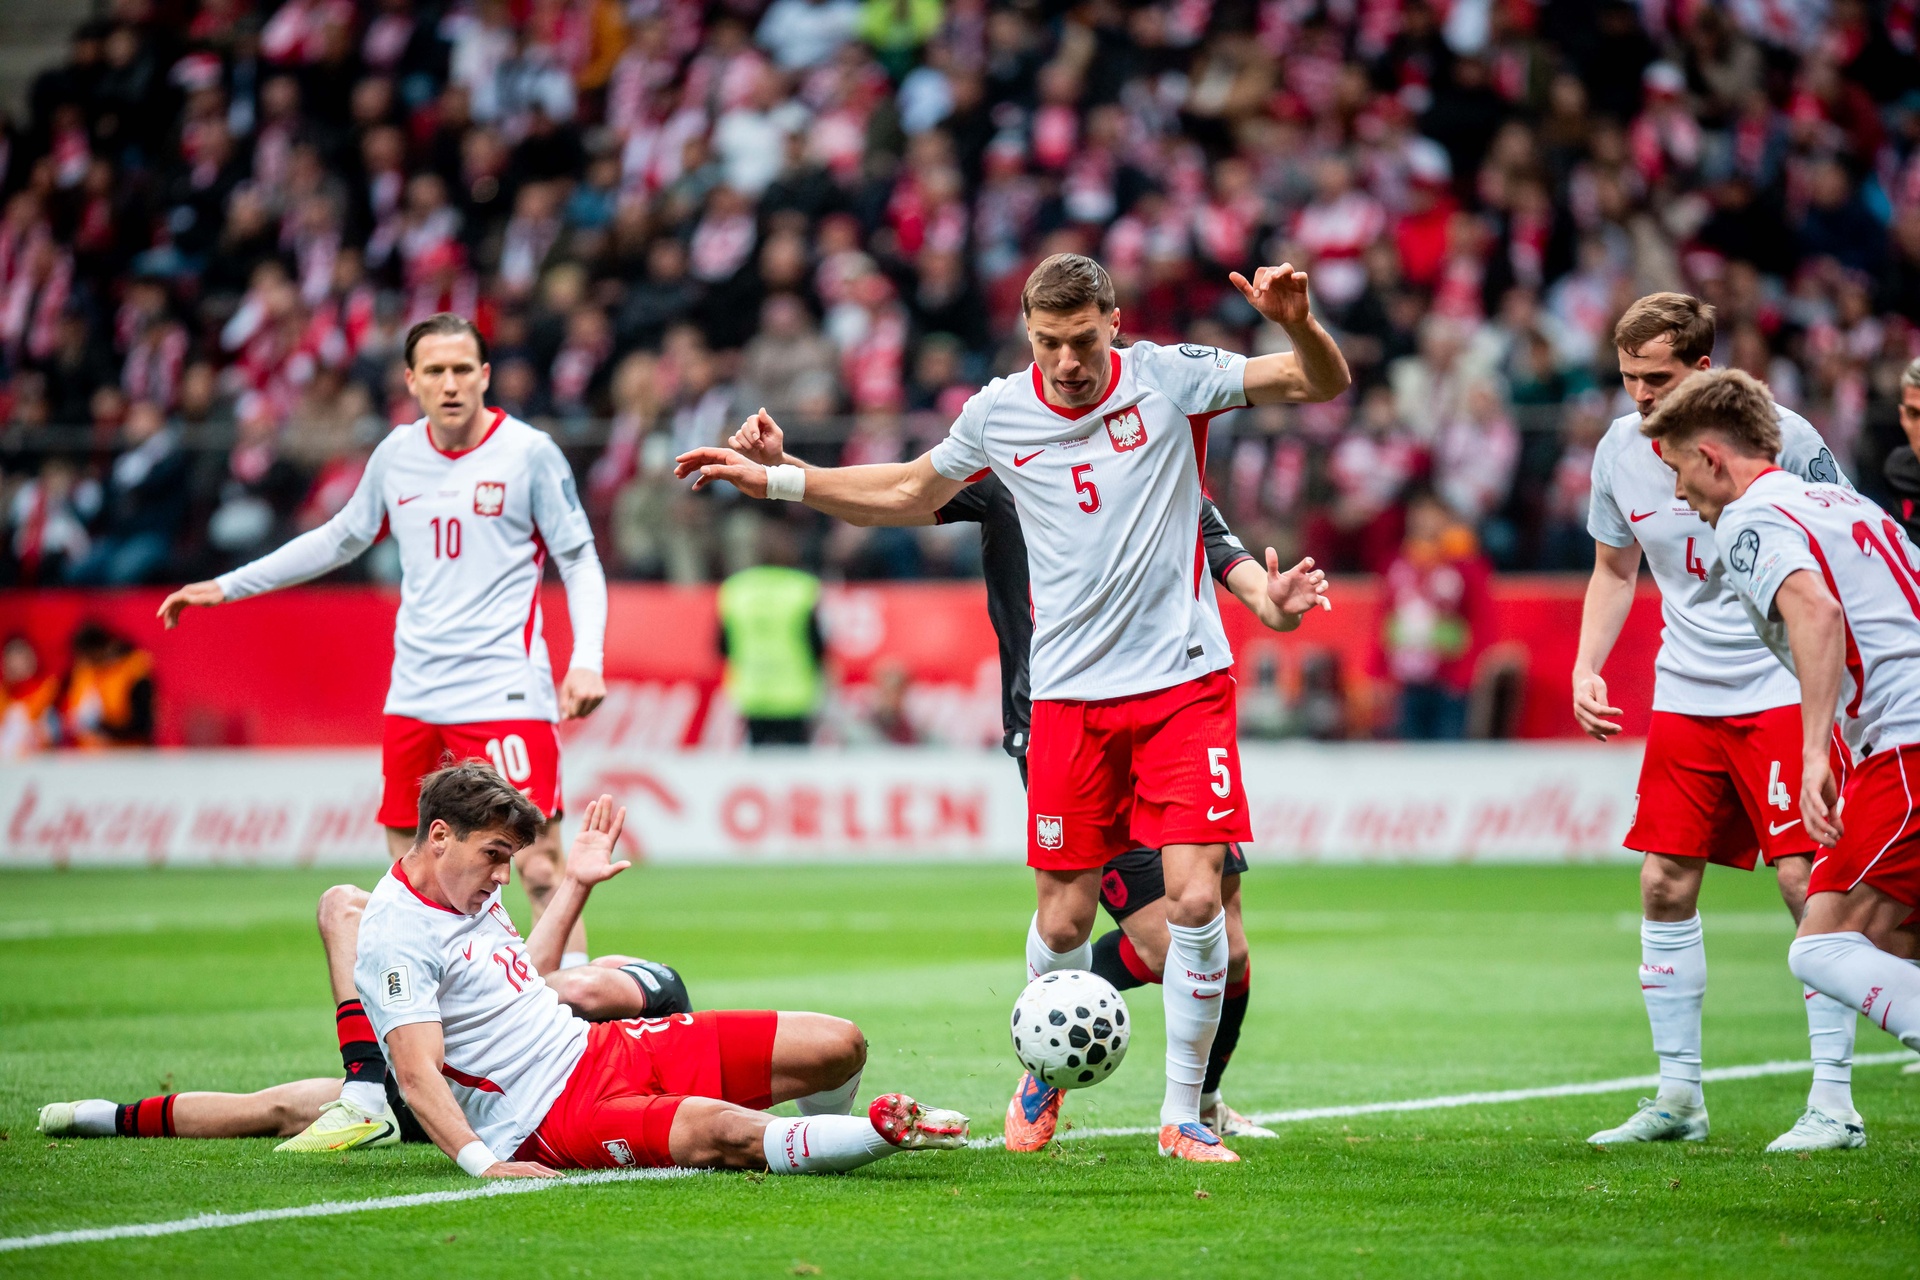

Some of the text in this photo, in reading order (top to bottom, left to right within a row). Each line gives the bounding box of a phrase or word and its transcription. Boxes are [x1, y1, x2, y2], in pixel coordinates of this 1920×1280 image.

[1070, 462, 1102, 515] 5
[430, 516, 462, 560] 10
[1686, 536, 1709, 583] 4
[485, 734, 532, 783] 10
[1207, 747, 1231, 799] 5
[1768, 760, 1791, 811] 4
[717, 781, 988, 844] ORLEN
[493, 945, 534, 994] 14
[1643, 963, 1675, 976] LSKA
[1862, 986, 1884, 1017] LSKA
[785, 1121, 804, 1168] POLSKA
